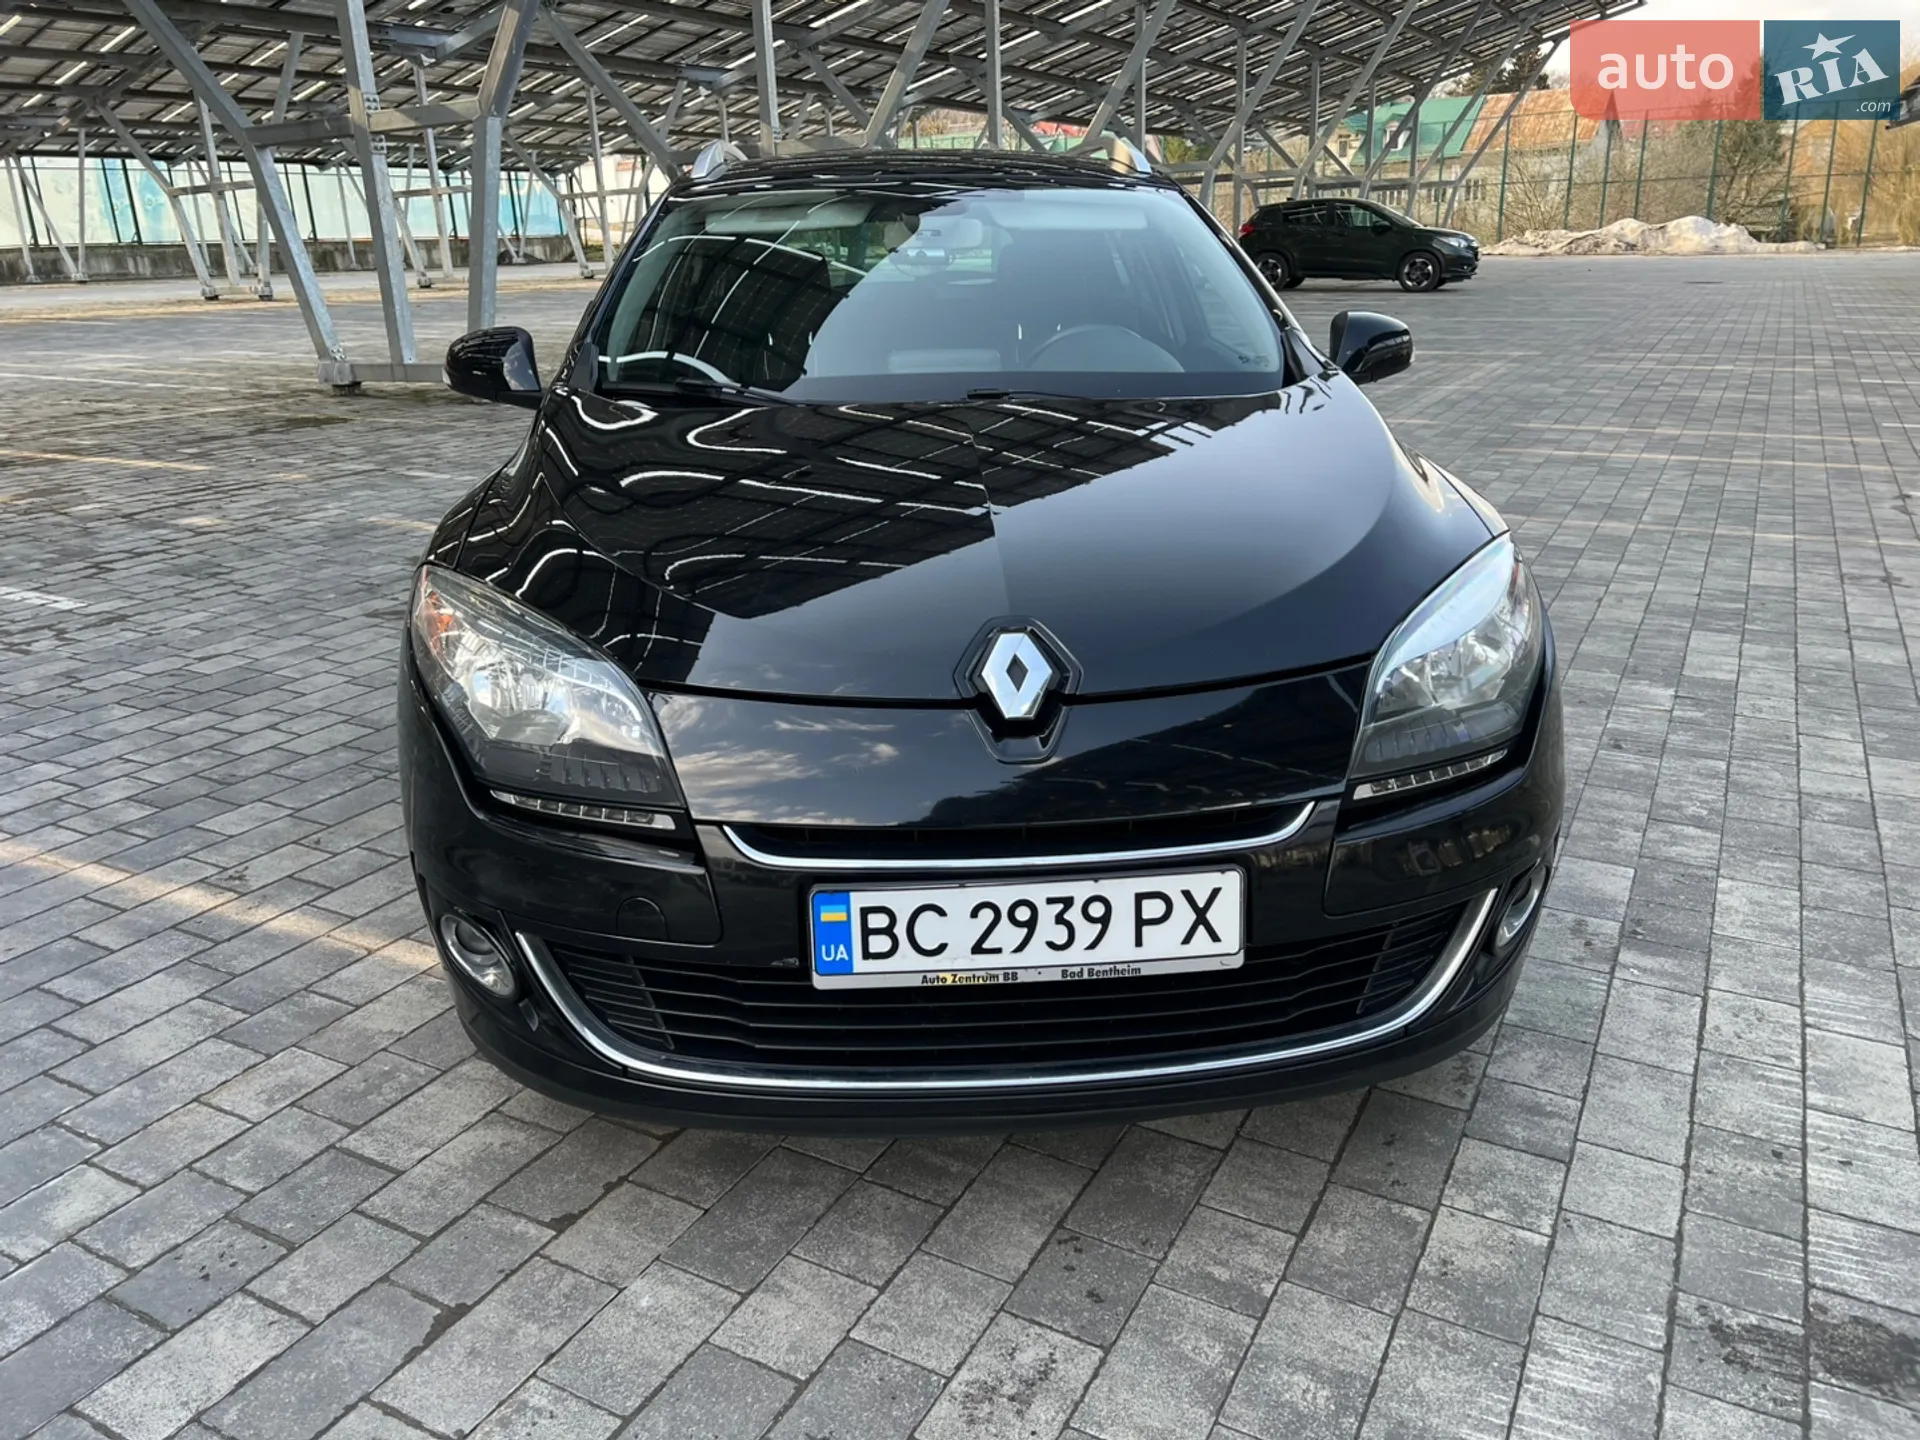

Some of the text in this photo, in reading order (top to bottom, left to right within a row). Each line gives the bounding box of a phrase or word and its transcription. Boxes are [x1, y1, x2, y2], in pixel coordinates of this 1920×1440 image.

[858, 886, 1223, 961] BC 2939 PX
[821, 945, 849, 962] UA
[921, 971, 1019, 985] Auto Zentrum BB
[1061, 964, 1142, 979] Bad Bentheim
